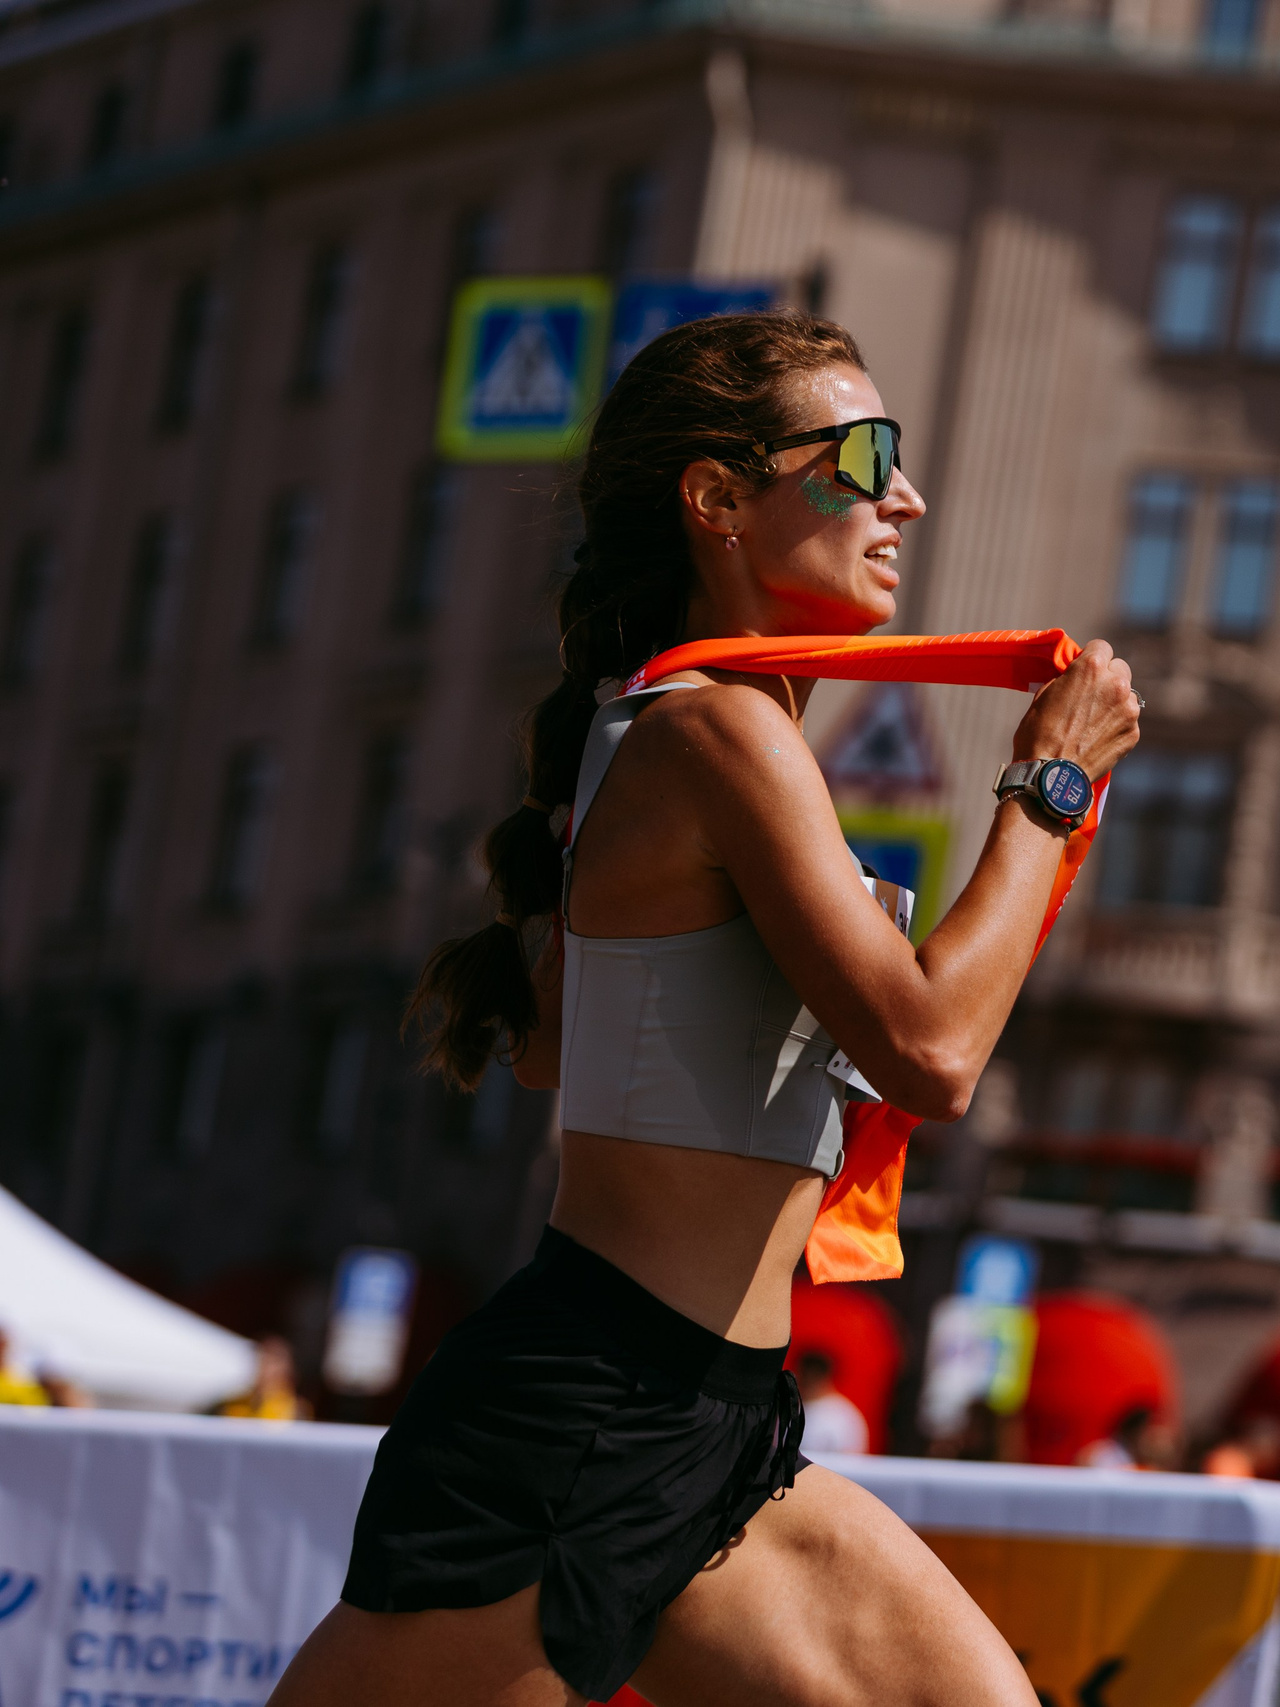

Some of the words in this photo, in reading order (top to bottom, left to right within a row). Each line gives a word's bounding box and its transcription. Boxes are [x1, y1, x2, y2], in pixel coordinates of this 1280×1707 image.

[1067, 785, 1083, 805] 179
[75, 1570, 168, 1616] МЫ
[65, 1630, 284, 1680] СПОРТИ
